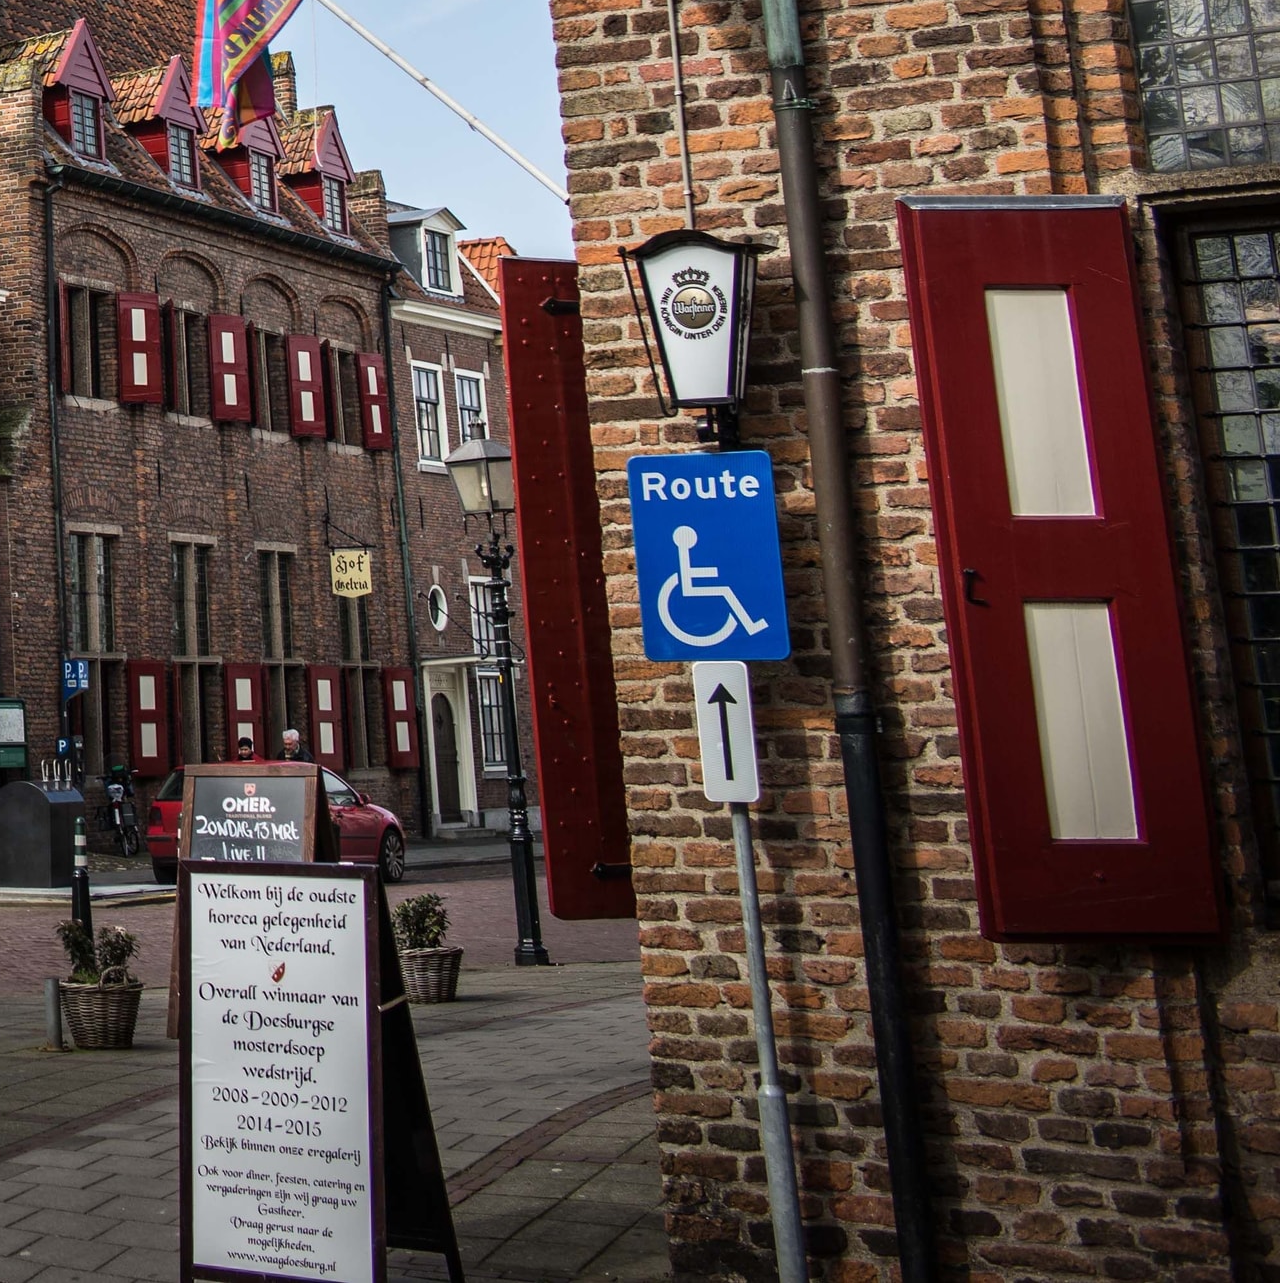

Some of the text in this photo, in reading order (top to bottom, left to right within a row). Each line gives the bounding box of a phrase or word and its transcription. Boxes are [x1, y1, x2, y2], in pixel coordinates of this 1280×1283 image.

[660, 285, 728, 340] EINE KÖNIGIN UNTER DEN BIEREN
[641, 469, 760, 501] Route
[335, 554, 364, 574] Hof
[59, 739, 67, 752] P
[254, 821, 270, 839] 13
[197, 883, 357, 908] Welkom bij de oudste
[208, 909, 347, 934] horeca gelegenheid
[221, 938, 246, 950] van
[198, 981, 359, 1007] Overall winnaar van
[222, 1009, 335, 1037] de Doesburgse
[233, 1039, 325, 1062] mosterdsoep
[212, 1086, 348, 1113] 2008-2009-2012
[237, 1114, 322, 1137] 2014-2015
[201, 1134, 361, 1167] Bekijk binnen onze eregalerij
[197, 1164, 219, 1178] Ook
[222, 1169, 243, 1179] voor
[313, 1179, 352, 1195] catering
[354, 1182, 365, 1192] en
[206, 1183, 357, 1210] vergaderingen zijn wij graag uw
[229, 1216, 333, 1238] Vraag gerust naar de
[227, 1250, 337, 1275] www.waagdoesburg.nl
